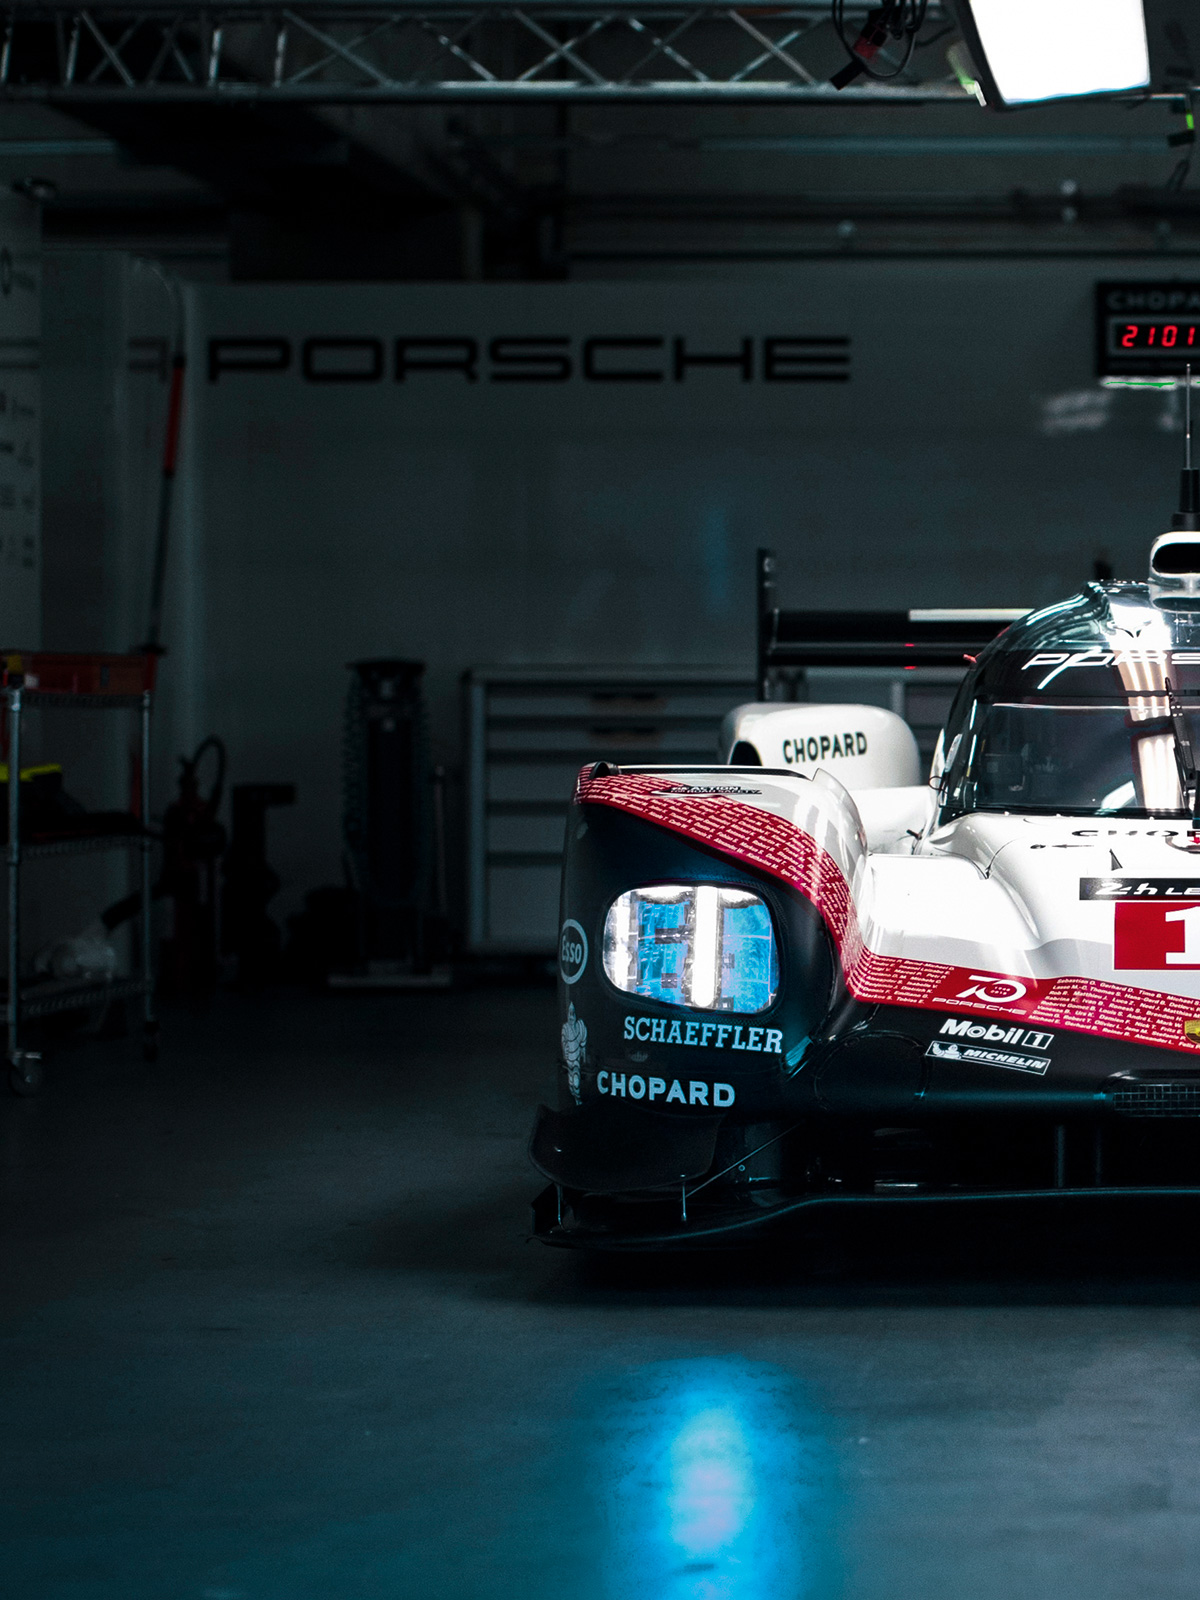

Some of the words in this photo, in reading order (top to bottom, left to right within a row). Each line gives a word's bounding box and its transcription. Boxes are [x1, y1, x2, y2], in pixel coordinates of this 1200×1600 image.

[208, 336, 849, 383] PORSCHE
[782, 731, 867, 764] CHOPARD
[562, 934, 582, 965] Esso
[955, 975, 1027, 1003] 70
[932, 997, 1028, 1016] PORSCHE
[624, 1015, 784, 1054] SCHAEFFLER
[939, 1018, 1025, 1045] Mobil
[963, 1048, 1047, 1069] MICHELIN
[596, 1069, 736, 1108] CHOPARD
